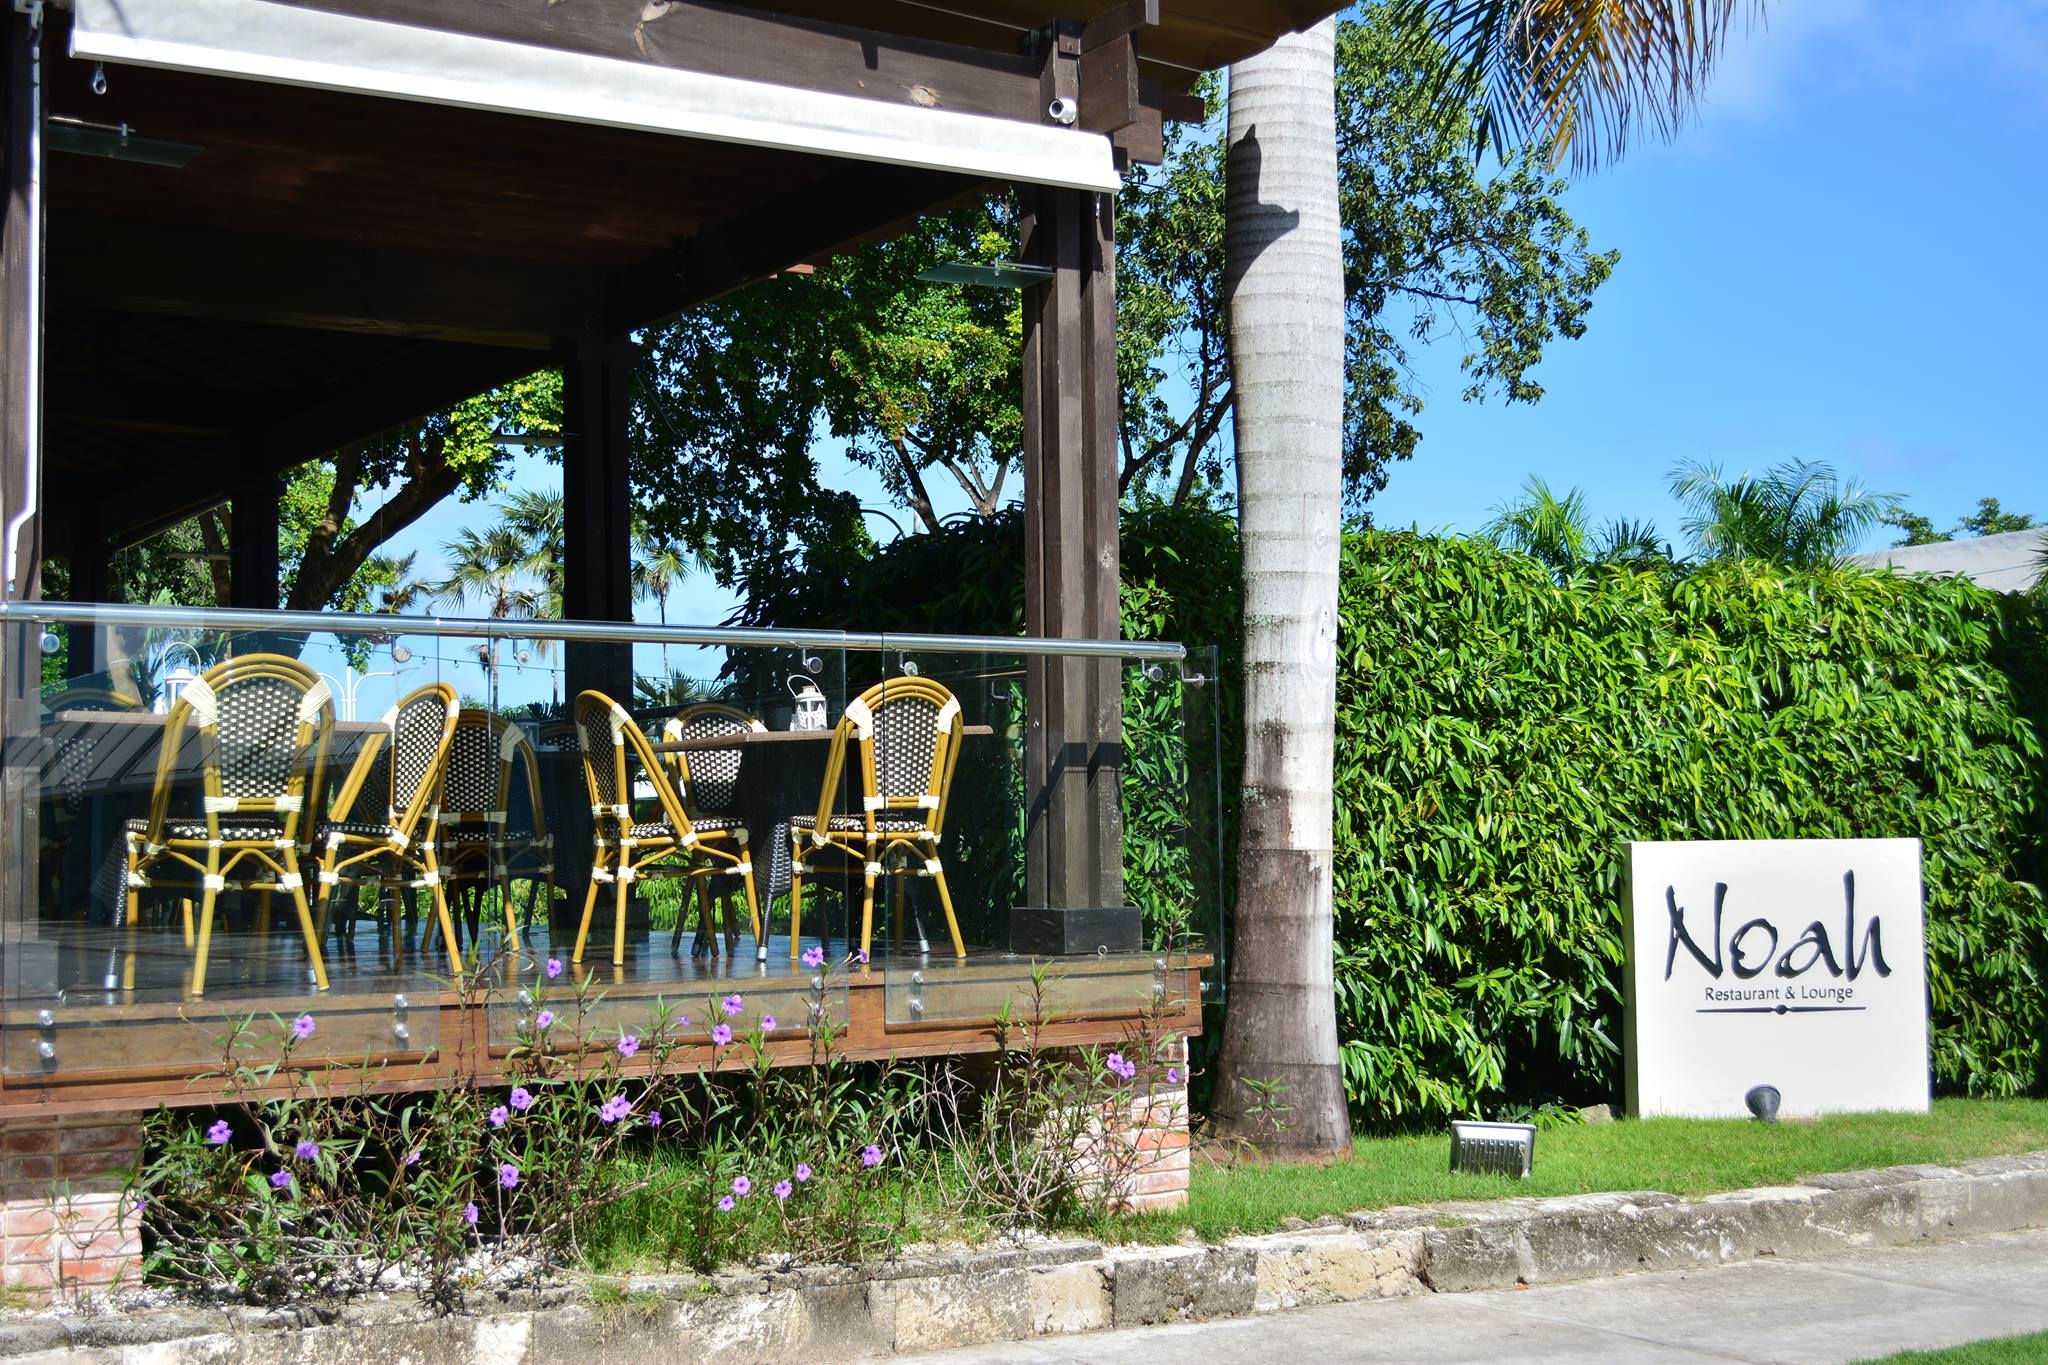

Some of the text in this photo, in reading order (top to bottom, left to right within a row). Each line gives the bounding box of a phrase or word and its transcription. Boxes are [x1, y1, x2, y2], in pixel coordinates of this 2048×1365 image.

[1664, 869, 1892, 982] Noah
[1705, 985, 1854, 1003] Restaurant & Lounge
